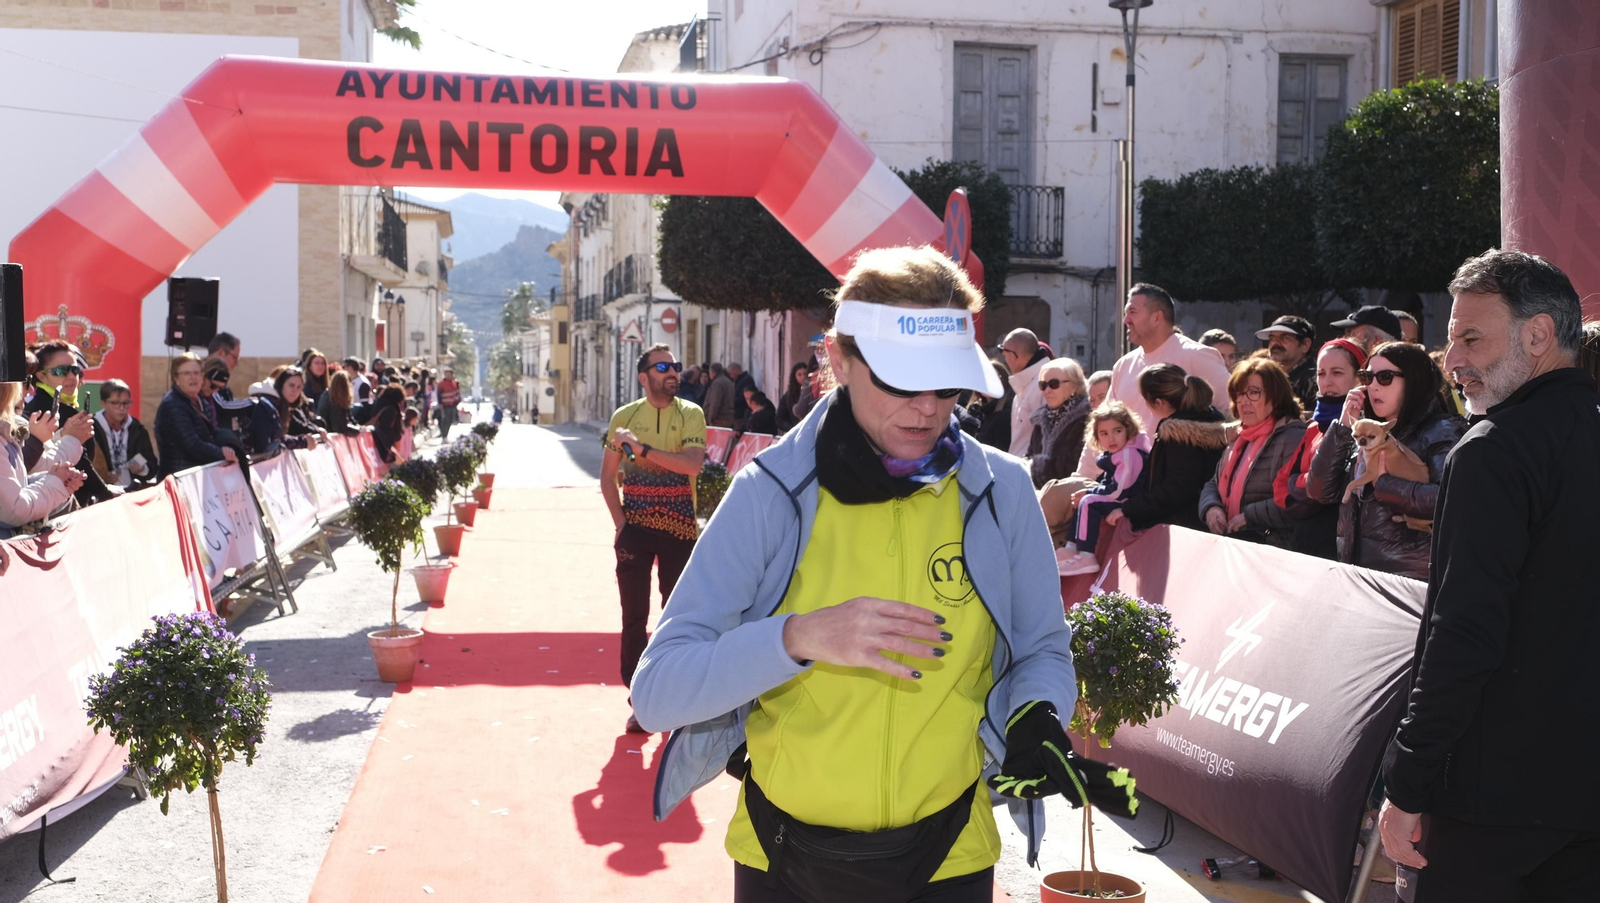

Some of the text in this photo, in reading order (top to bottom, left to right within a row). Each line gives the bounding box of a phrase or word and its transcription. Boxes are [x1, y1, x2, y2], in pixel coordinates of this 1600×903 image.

[335, 69, 698, 111] AYUNTAMIENTO
[346, 115, 685, 178] CANTORIA
[897, 316, 916, 335] 10
[917, 317, 955, 325] CARRERA
[918, 325, 956, 333] POPULAR
[1168, 659, 1309, 745] EAMERGY
[1156, 726, 1236, 777] www.teamergy.es
